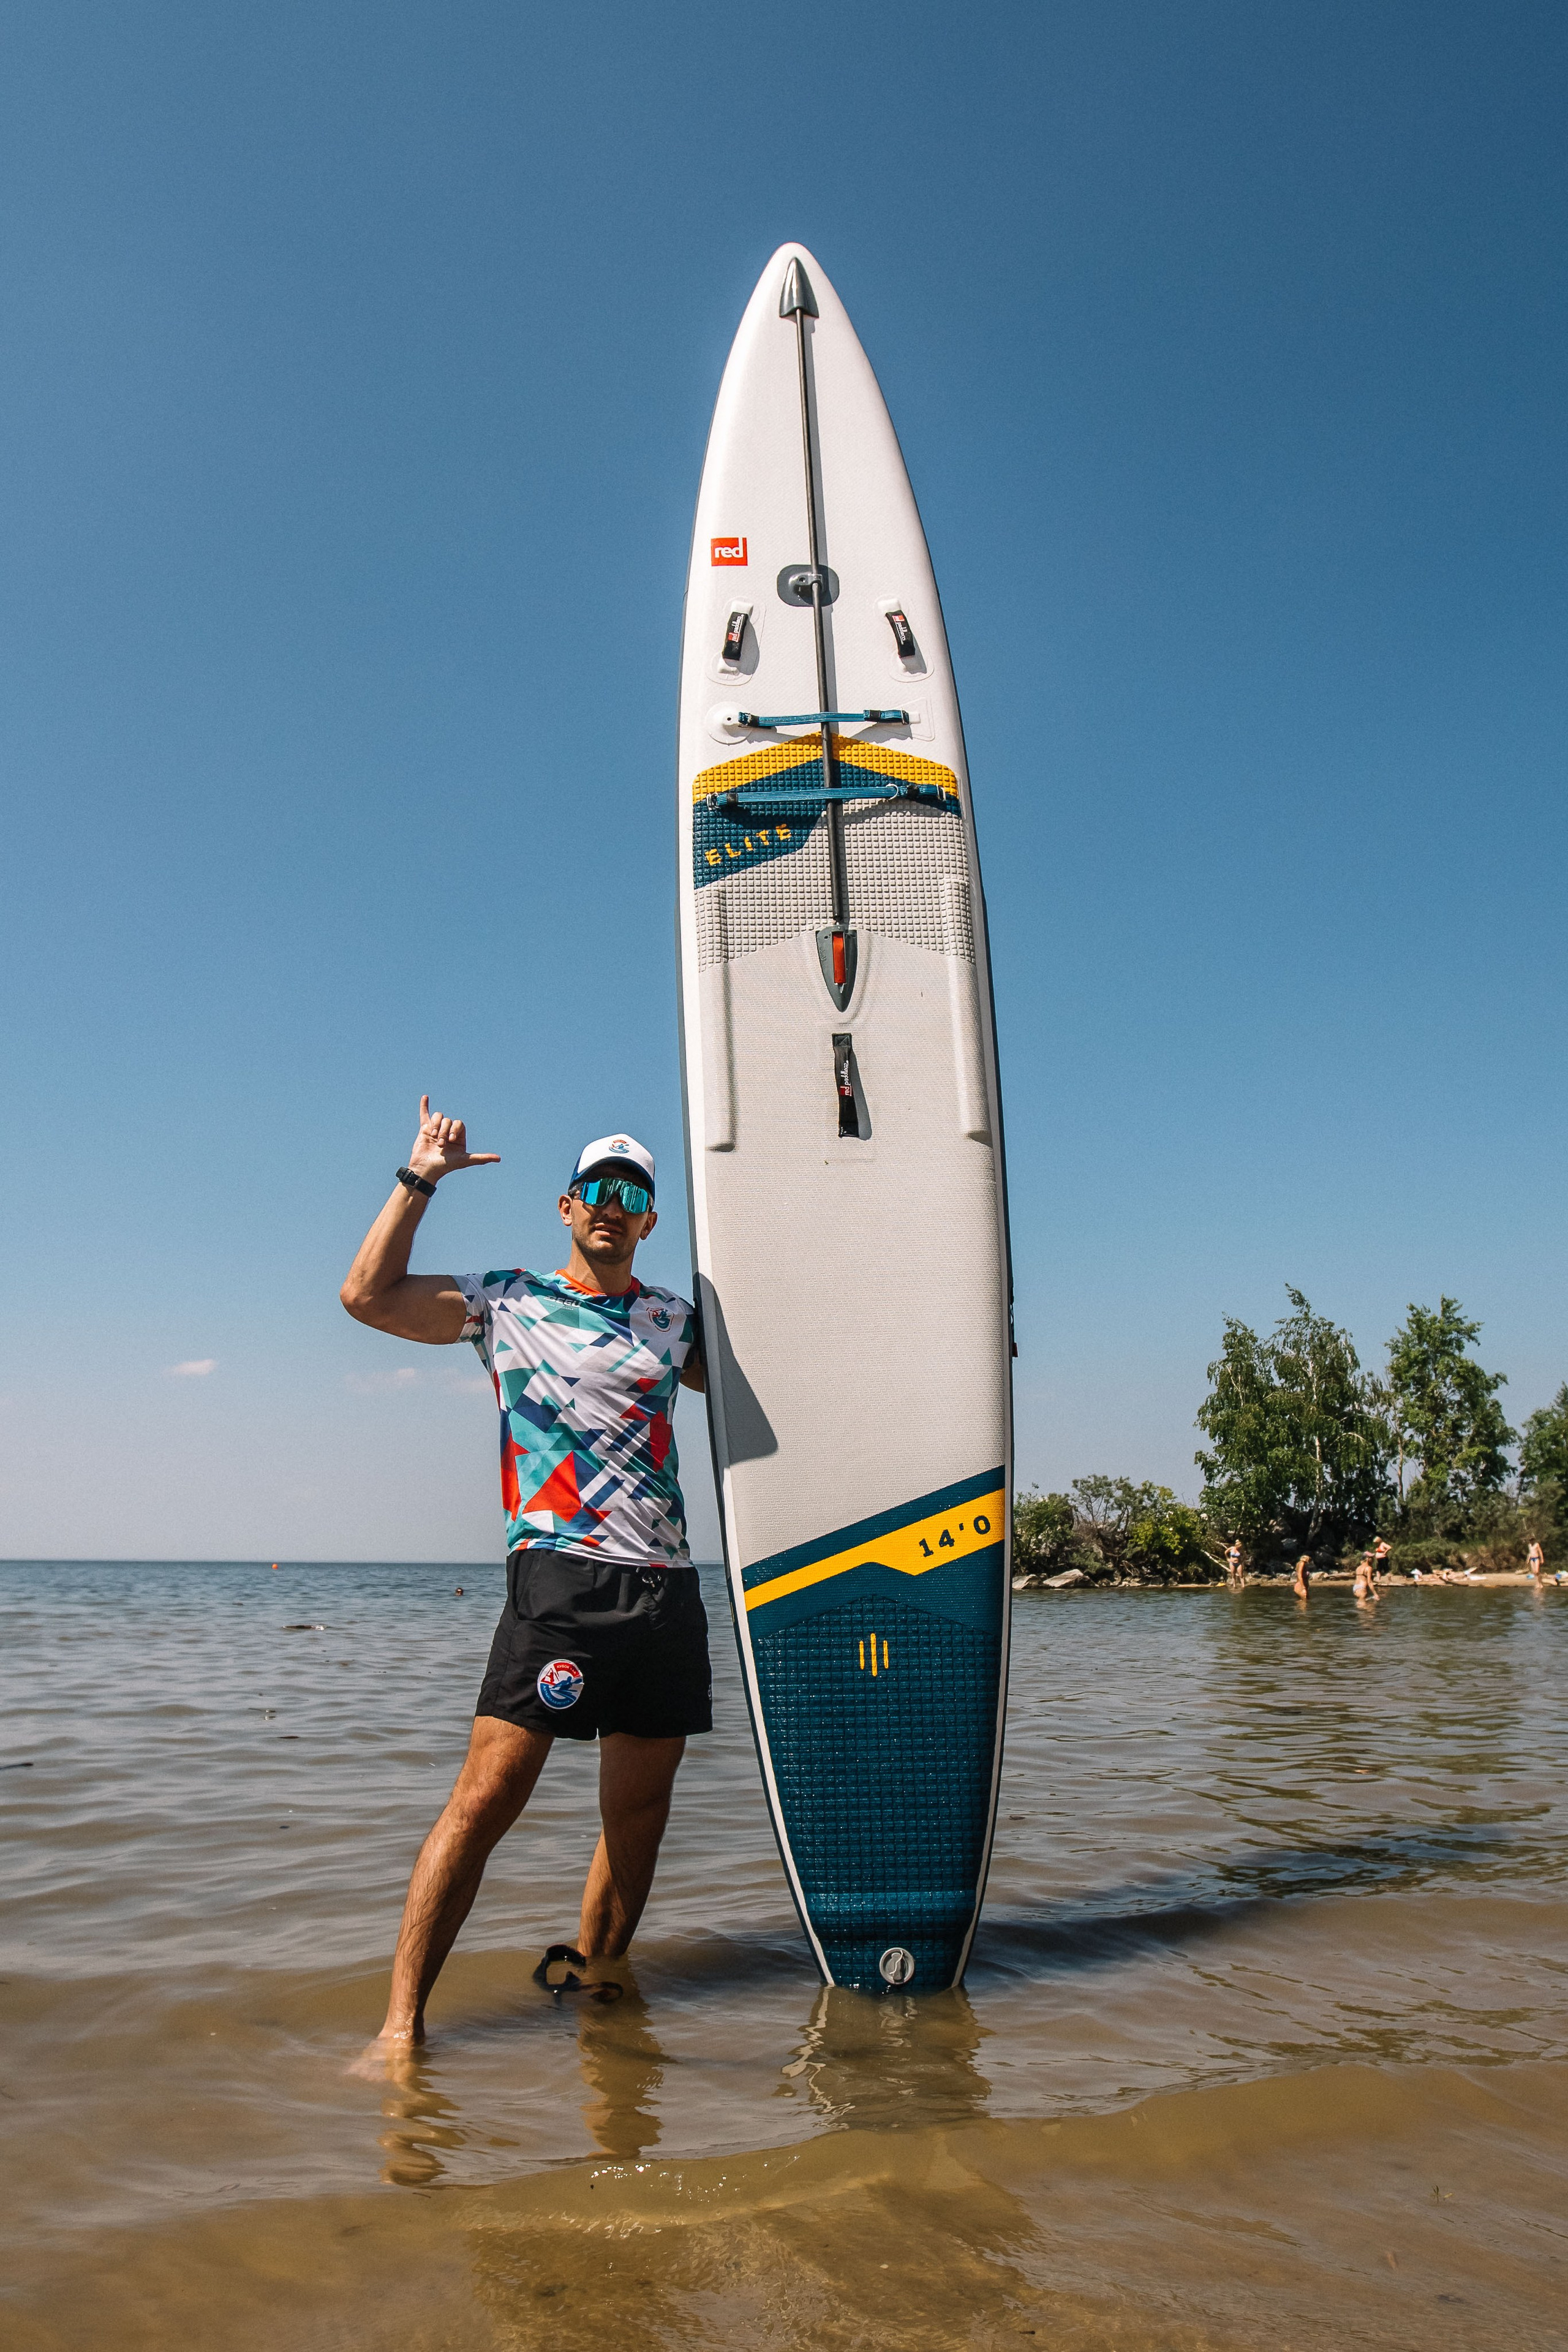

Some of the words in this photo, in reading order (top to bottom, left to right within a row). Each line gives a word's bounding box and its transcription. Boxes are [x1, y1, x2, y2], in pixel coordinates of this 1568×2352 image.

[714, 537, 744, 558] red
[704, 823, 792, 866] ELITE
[840, 1086, 850, 1096] red
